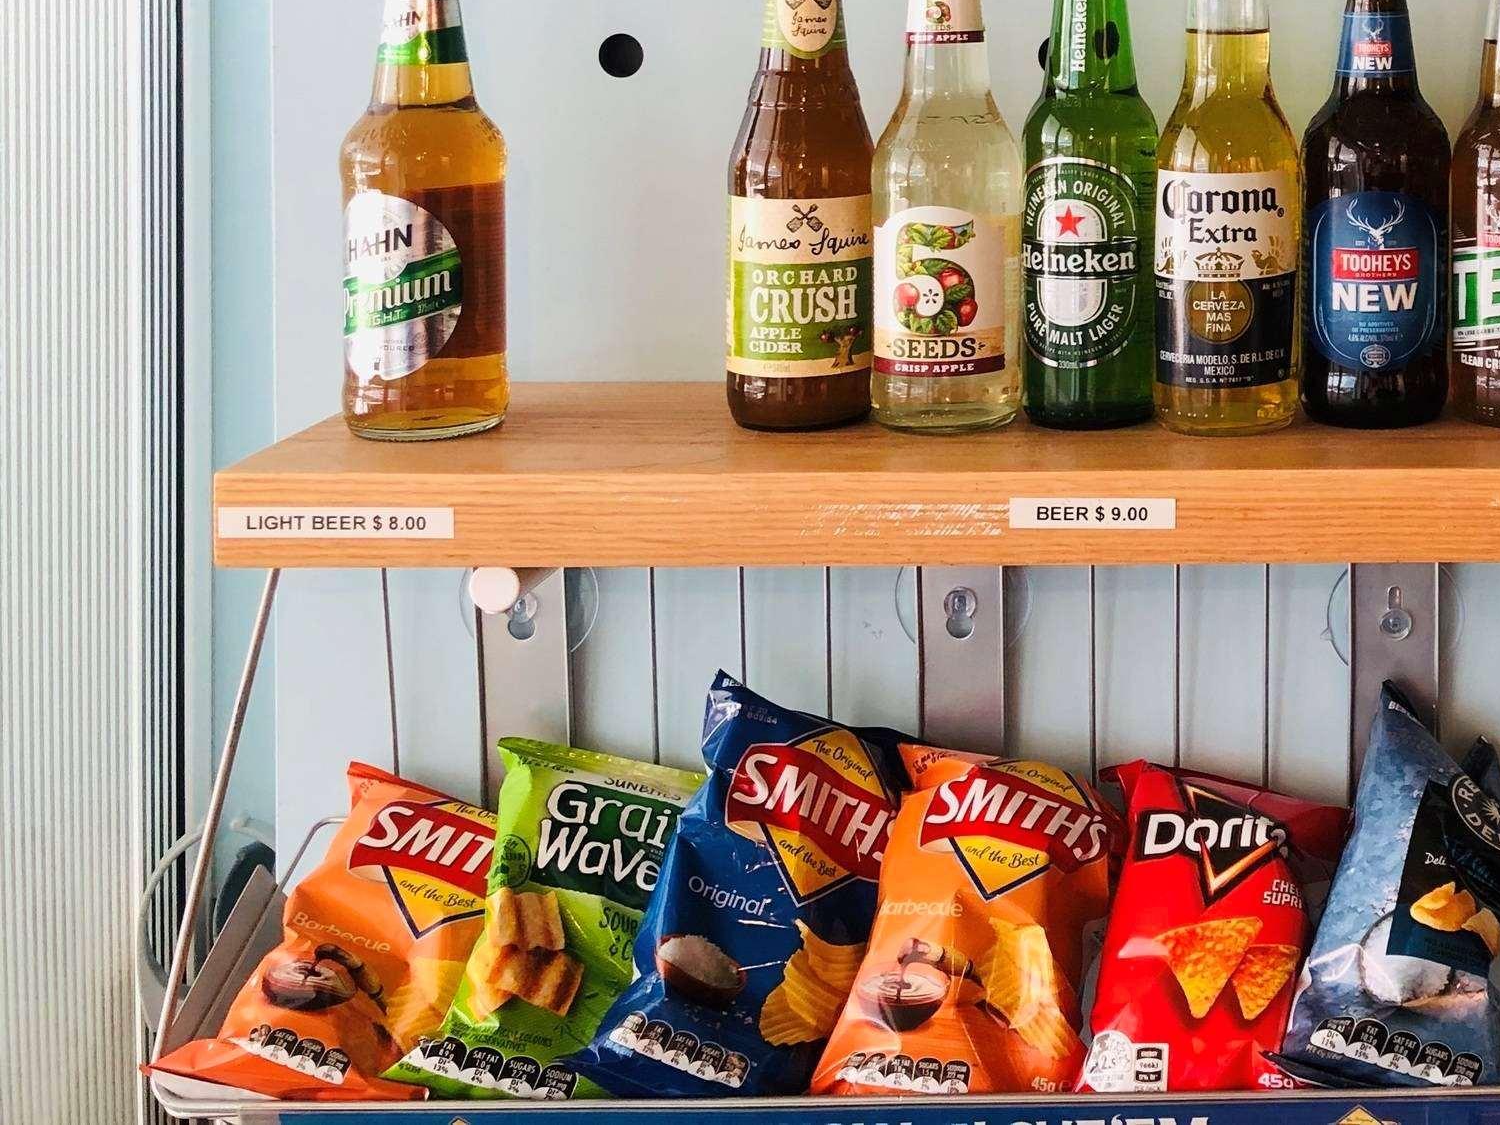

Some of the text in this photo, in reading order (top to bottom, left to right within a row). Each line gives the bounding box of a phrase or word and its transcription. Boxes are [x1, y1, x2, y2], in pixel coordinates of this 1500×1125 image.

[1352, 56, 1393, 71] NEW
[1073, 179, 1127, 230] ORIGINAL
[1162, 179, 1280, 223] Corona
[1188, 217, 1258, 245] Extra
[349, 224, 413, 262] HAHN
[1022, 242, 1136, 275] Heineken
[1340, 253, 1412, 273] TOOHEYS
[752, 266, 858, 286] ORCHARD
[751, 284, 858, 325] CRUSH
[1192, 300, 1246, 311] CERVEZA
[1210, 290, 1227, 301] LA
[1332, 281, 1418, 313] NEW
[1026, 302, 1048, 339] PURE
[1049, 329, 1084, 347] MALT
[1088, 303, 1126, 343] LAGER
[1206, 312, 1232, 322] MAS
[750, 327, 802, 340] APPLE
[1205, 323, 1232, 333] FINA
[749, 341, 804, 354] CIDER
[892, 338, 977, 360] SEEDS
[894, 362, 975, 374] CRISP APPLE
[1460, 353, 1484, 367] CLEAN
[1204, 365, 1235, 376] MEXICO
[246, 514, 426, 531] LIGHT BEER $ 8.00
[1036, 505, 1148, 522] BEER $ 9.00
[812, 738, 877, 782] The Original
[1025, 764, 1074, 794] Original
[926, 776, 1108, 862] SMITH'S
[778, 838, 802, 858] and
[965, 843, 1040, 869] and the Best
[1424, 852, 1447, 866] Deli
[399, 879, 477, 909] and Best
[688, 874, 772, 917] Original
[293, 910, 392, 956] Barbecue
[1031, 1076, 1057, 1094] 45g
[1258, 1072, 1294, 1089] 45g
